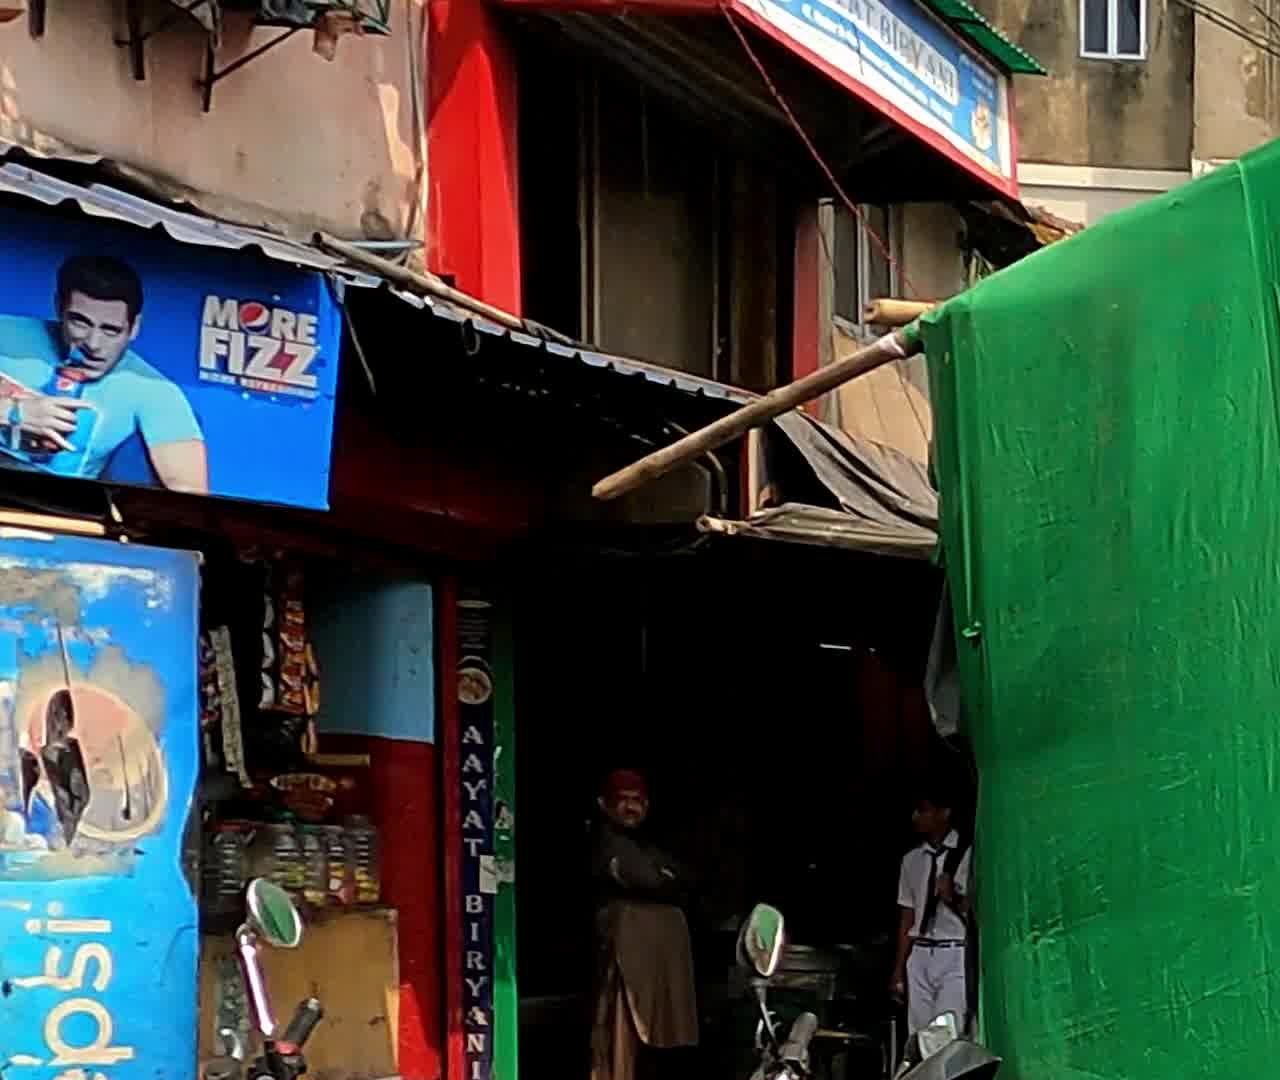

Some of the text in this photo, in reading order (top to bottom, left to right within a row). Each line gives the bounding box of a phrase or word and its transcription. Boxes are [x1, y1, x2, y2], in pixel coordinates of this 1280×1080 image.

[200, 325, 319, 388] FIZZ
[462, 725, 489, 1080] AAYAT BIRYANI
